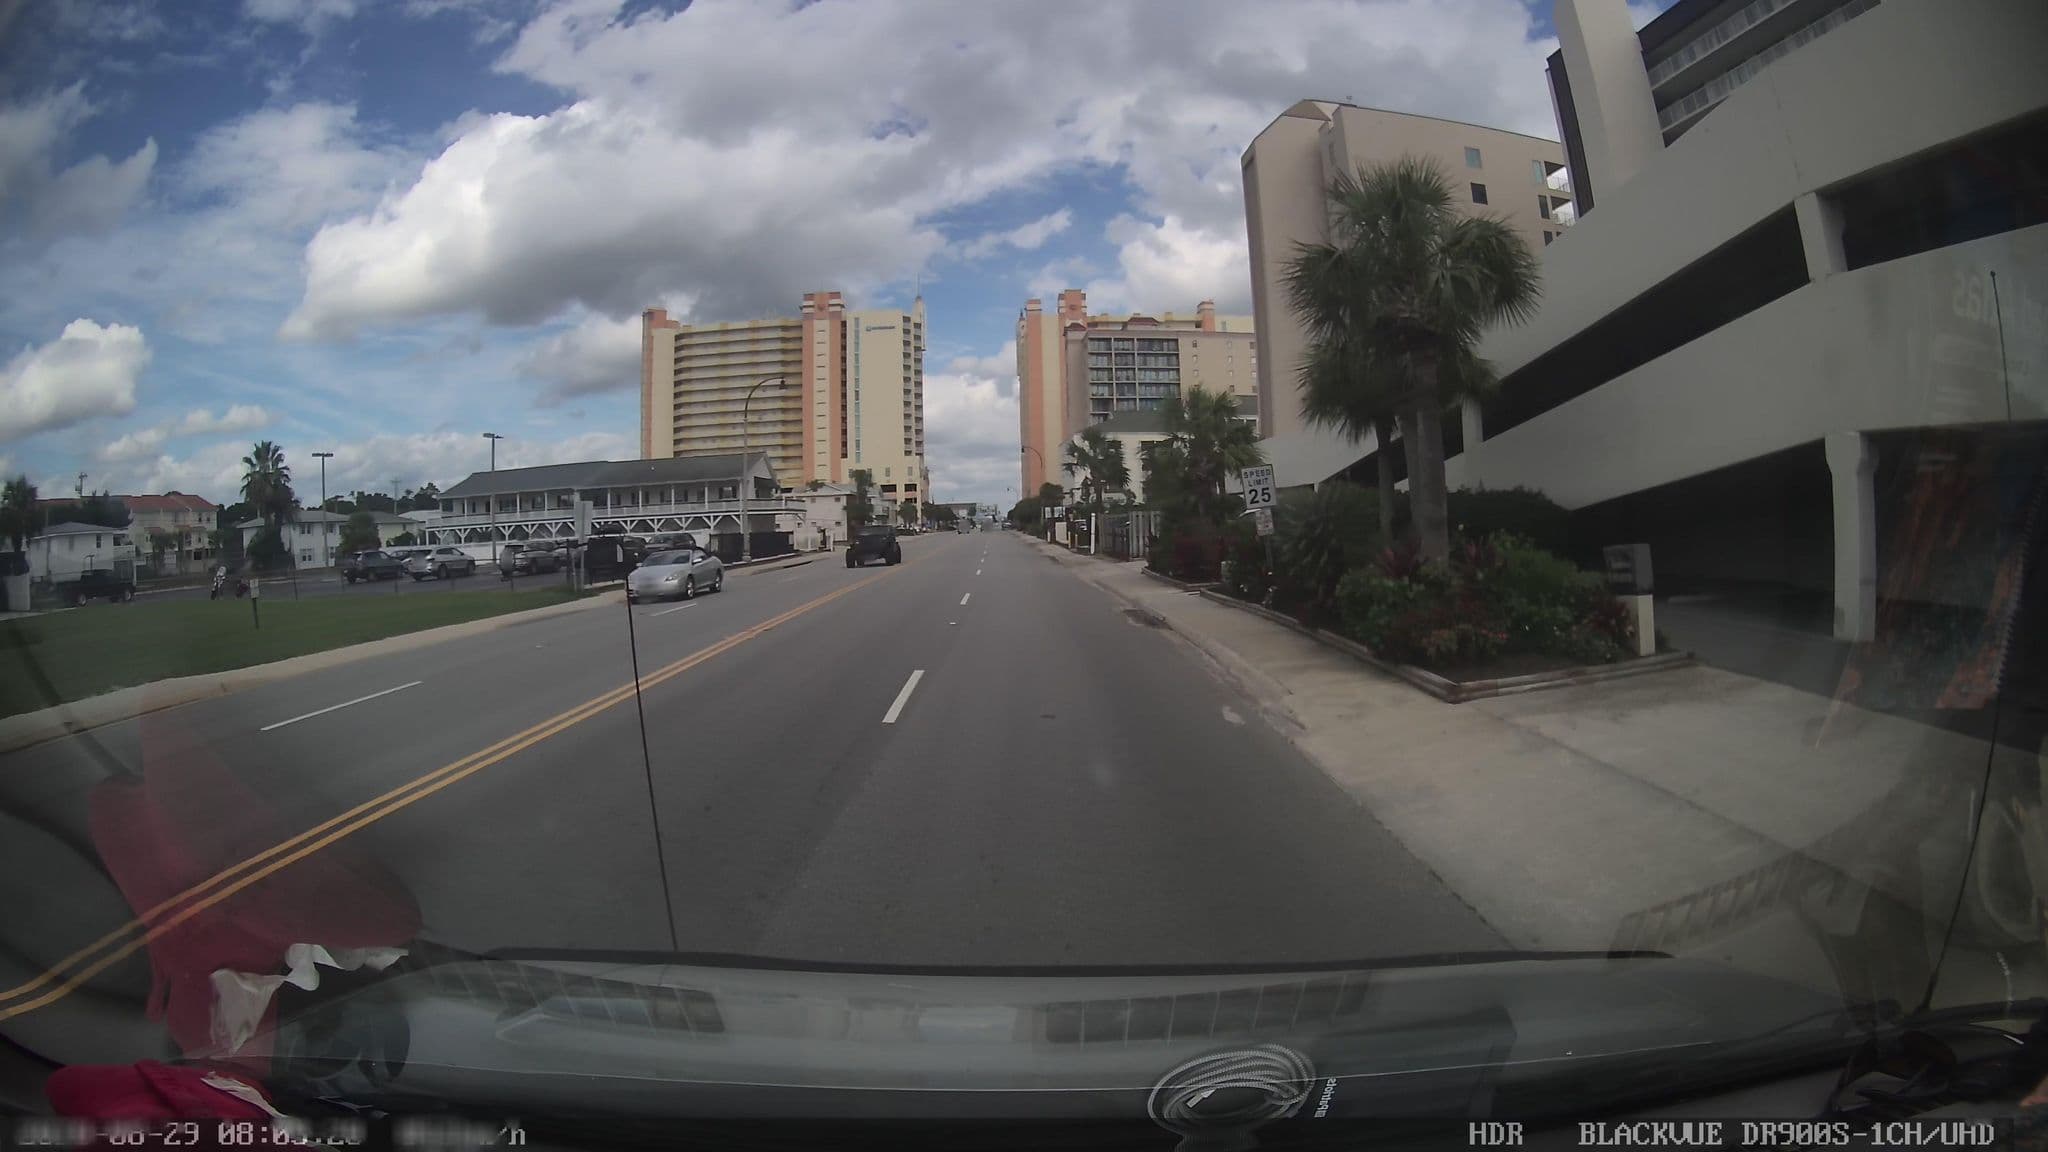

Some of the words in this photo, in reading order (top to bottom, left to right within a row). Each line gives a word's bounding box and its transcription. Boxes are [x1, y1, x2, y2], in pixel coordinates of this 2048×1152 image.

[1243, 469, 1271, 478] SPEED
[1248, 478, 1269, 487] LIMIT
[1249, 487, 1271, 504] 25
